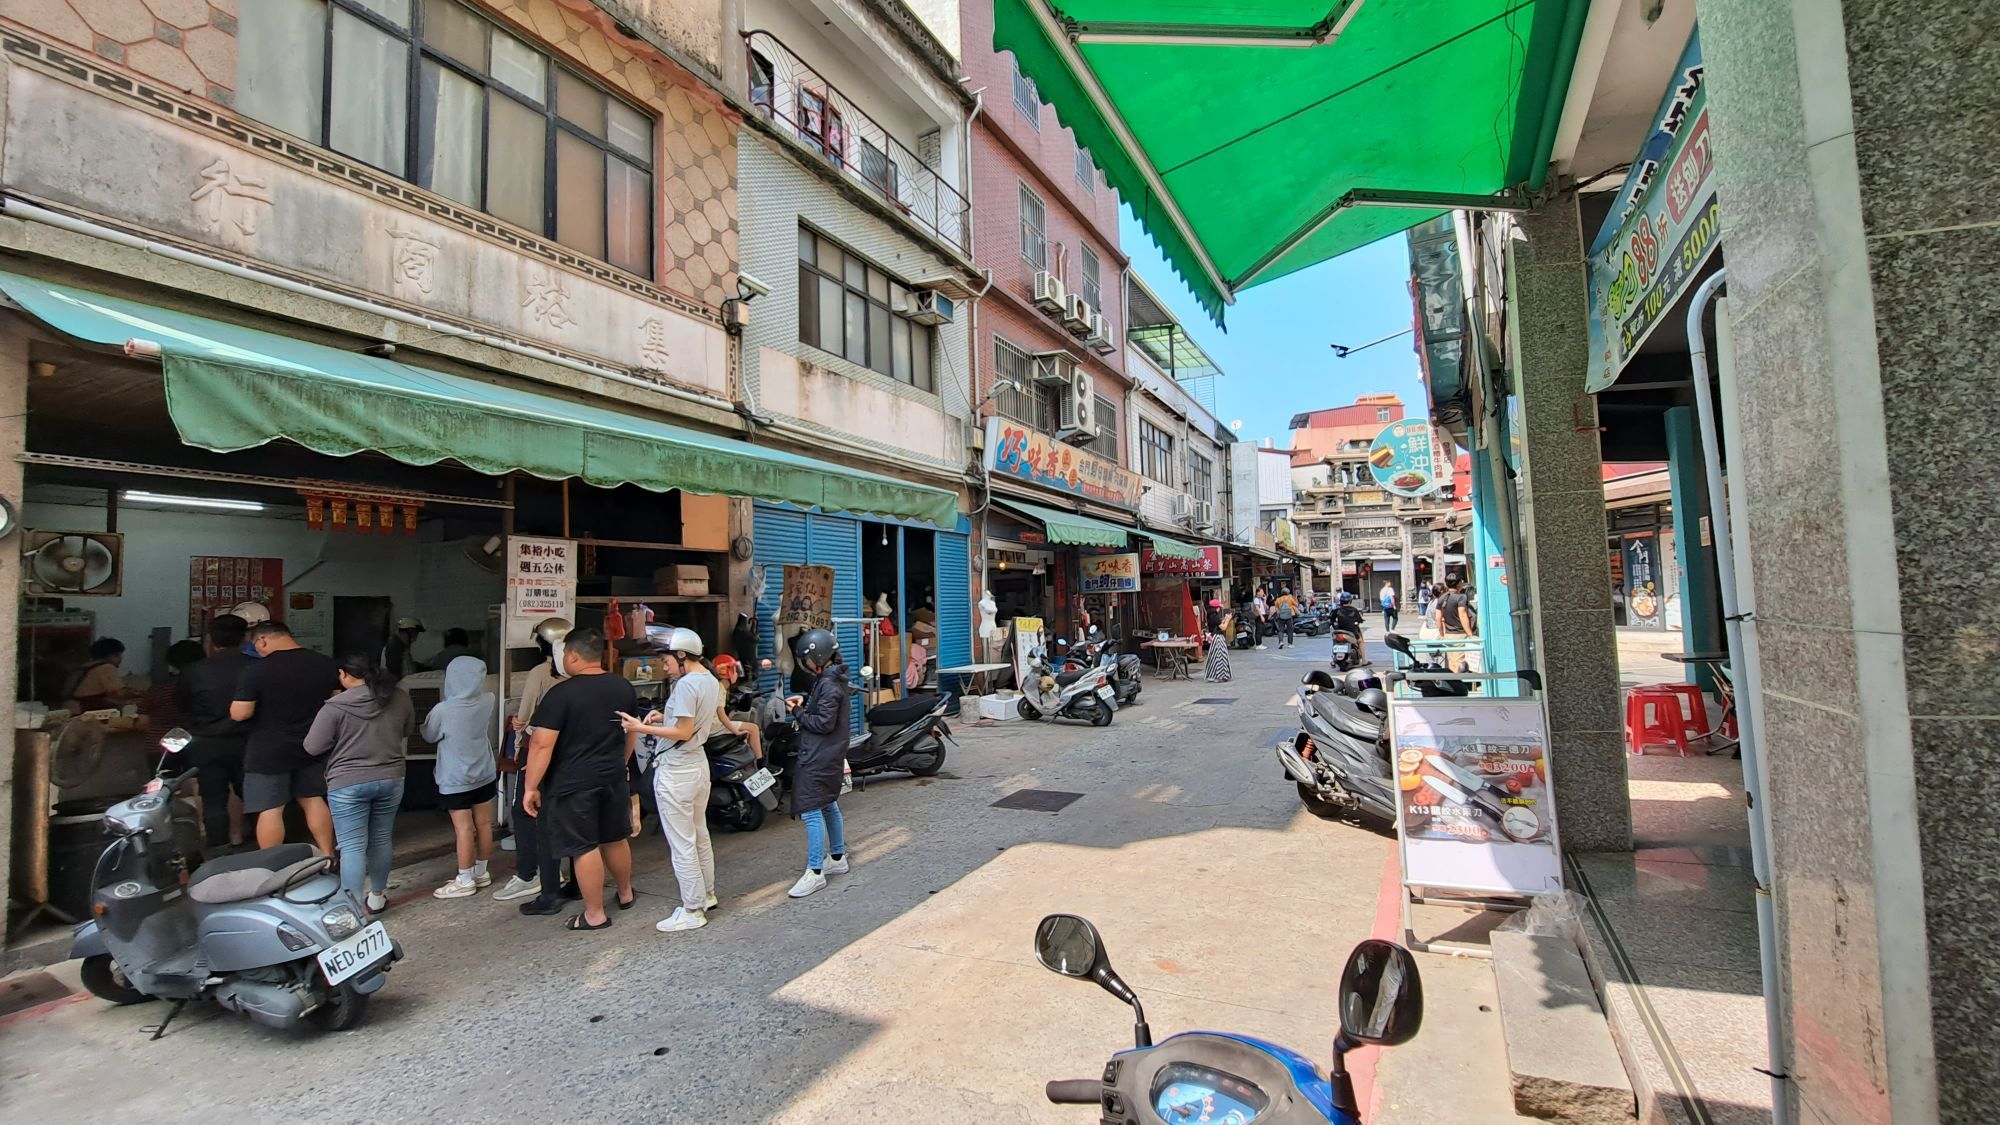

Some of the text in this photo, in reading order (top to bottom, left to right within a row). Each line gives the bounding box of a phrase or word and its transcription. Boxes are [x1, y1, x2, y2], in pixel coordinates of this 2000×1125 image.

[1001, 426, 1059, 480] 巧味香
[519, 543, 566, 559] 集裕小吃
[519, 560, 565, 575] 週五公休
[1095, 559, 1134, 573] 巧味香
[324, 929, 385, 978] NED-6777
